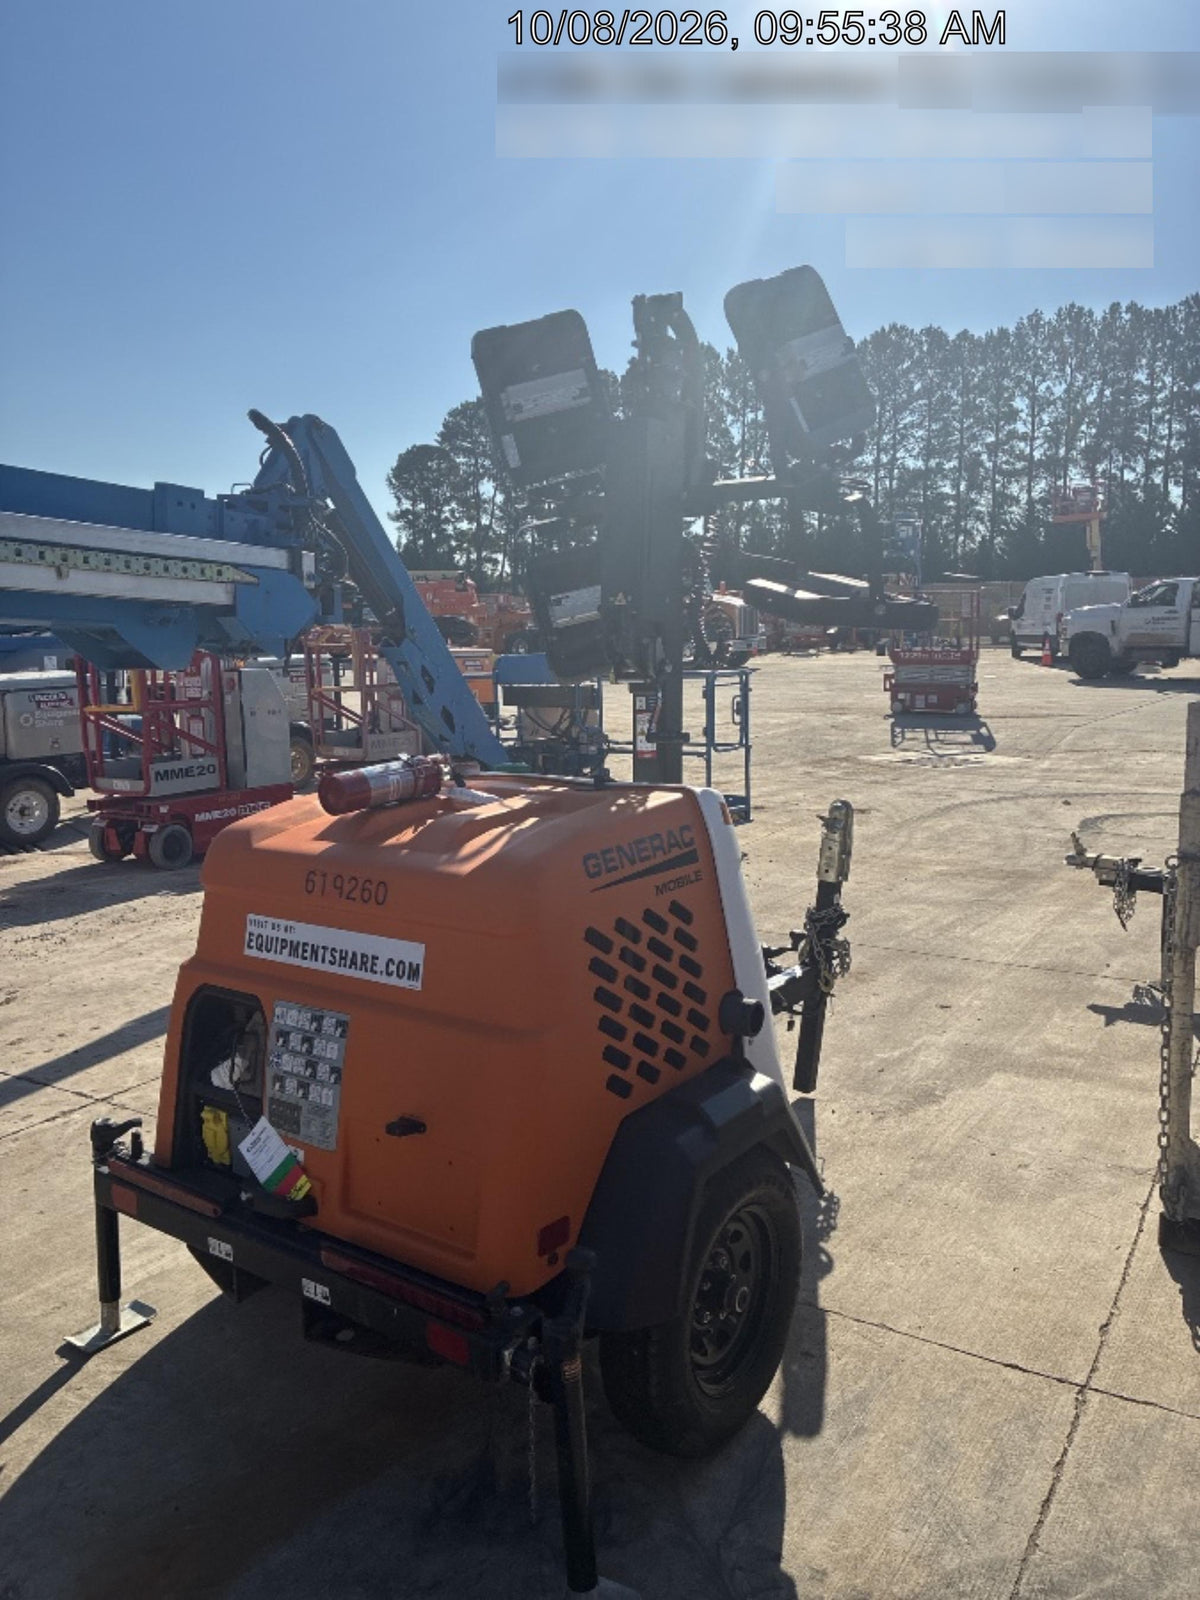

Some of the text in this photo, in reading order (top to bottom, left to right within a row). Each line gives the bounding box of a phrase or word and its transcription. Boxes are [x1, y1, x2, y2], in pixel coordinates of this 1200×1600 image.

[154, 763, 216, 782] MME20
[195, 808, 237, 822] MME20
[582, 825, 695, 879] GENERAC
[305, 870, 388, 906] 619260
[654, 870, 703, 896] MOBILE
[247, 931, 421, 983] EQUIPMENTSHARE.COM
